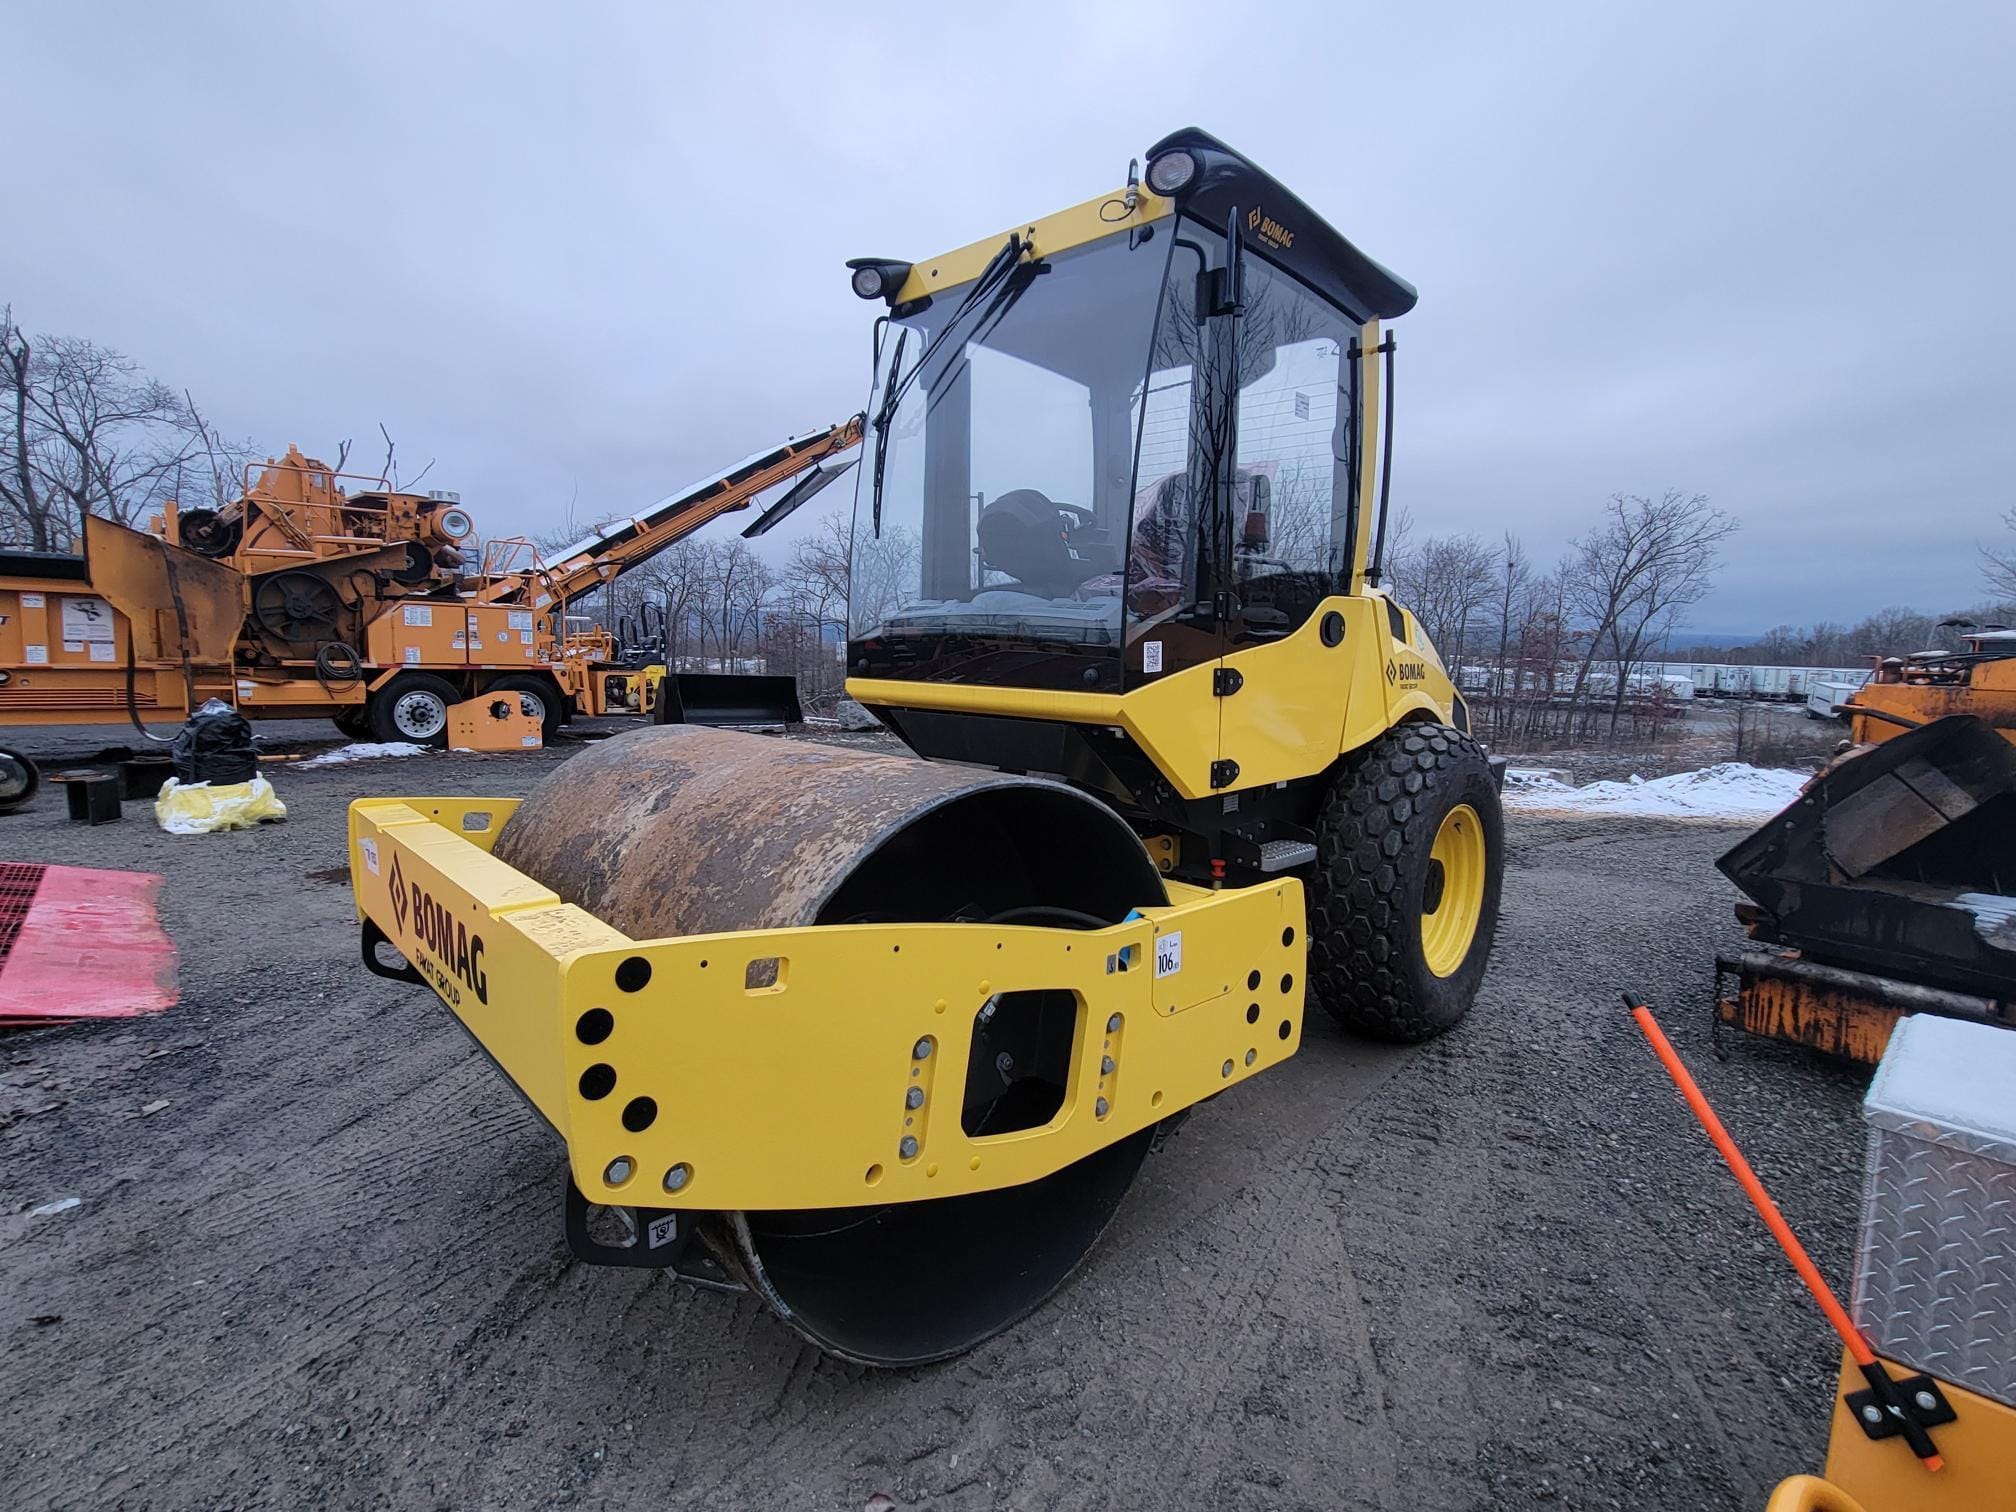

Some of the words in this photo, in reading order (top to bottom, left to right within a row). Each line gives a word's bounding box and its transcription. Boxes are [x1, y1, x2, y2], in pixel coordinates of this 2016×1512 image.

[1261, 217, 1295, 248] BOMAG
[1399, 663, 1425, 680] BOMAG
[412, 882, 487, 1006] BOMAG
[1158, 952, 1173, 974] 106
[436, 969, 460, 1007] GROUP
